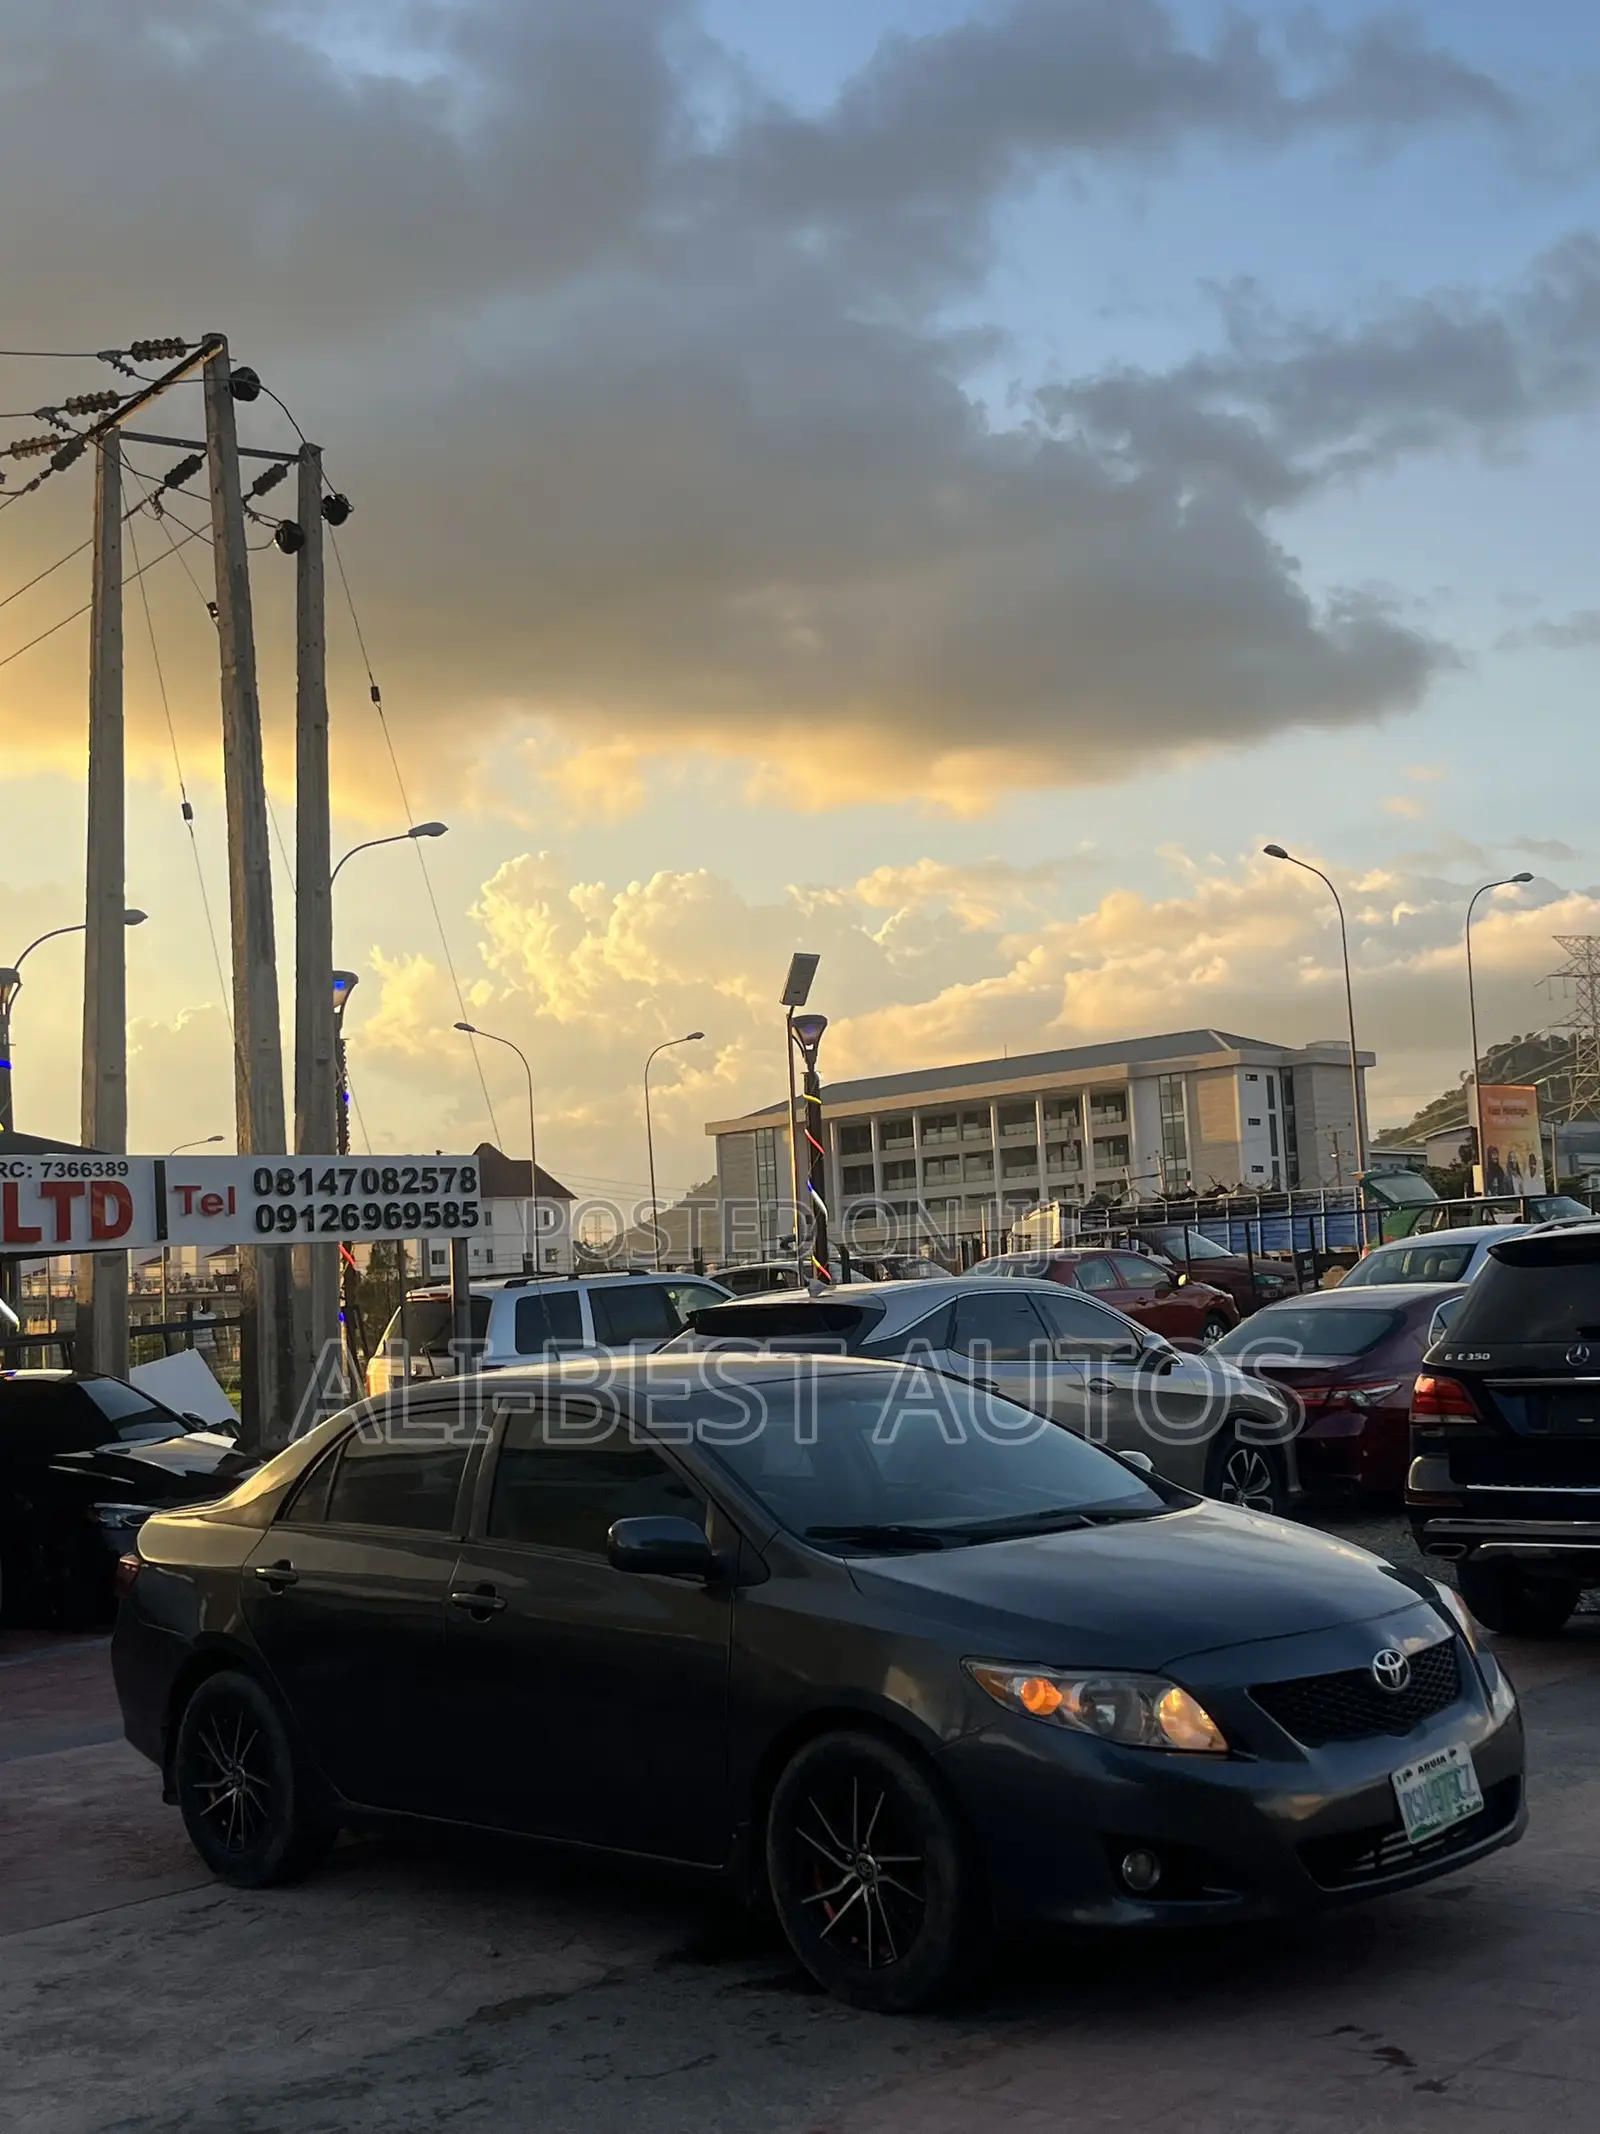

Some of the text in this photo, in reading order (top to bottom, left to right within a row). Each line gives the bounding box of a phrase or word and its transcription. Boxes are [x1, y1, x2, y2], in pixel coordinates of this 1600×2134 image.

[40, 1161, 129, 1178] 7366389
[253, 1167, 477, 1196] 08147082578
[3, 1180, 134, 1243] LTD
[173, 1185, 236, 1216] Tel
[255, 1201, 479, 1233] 09126969585
